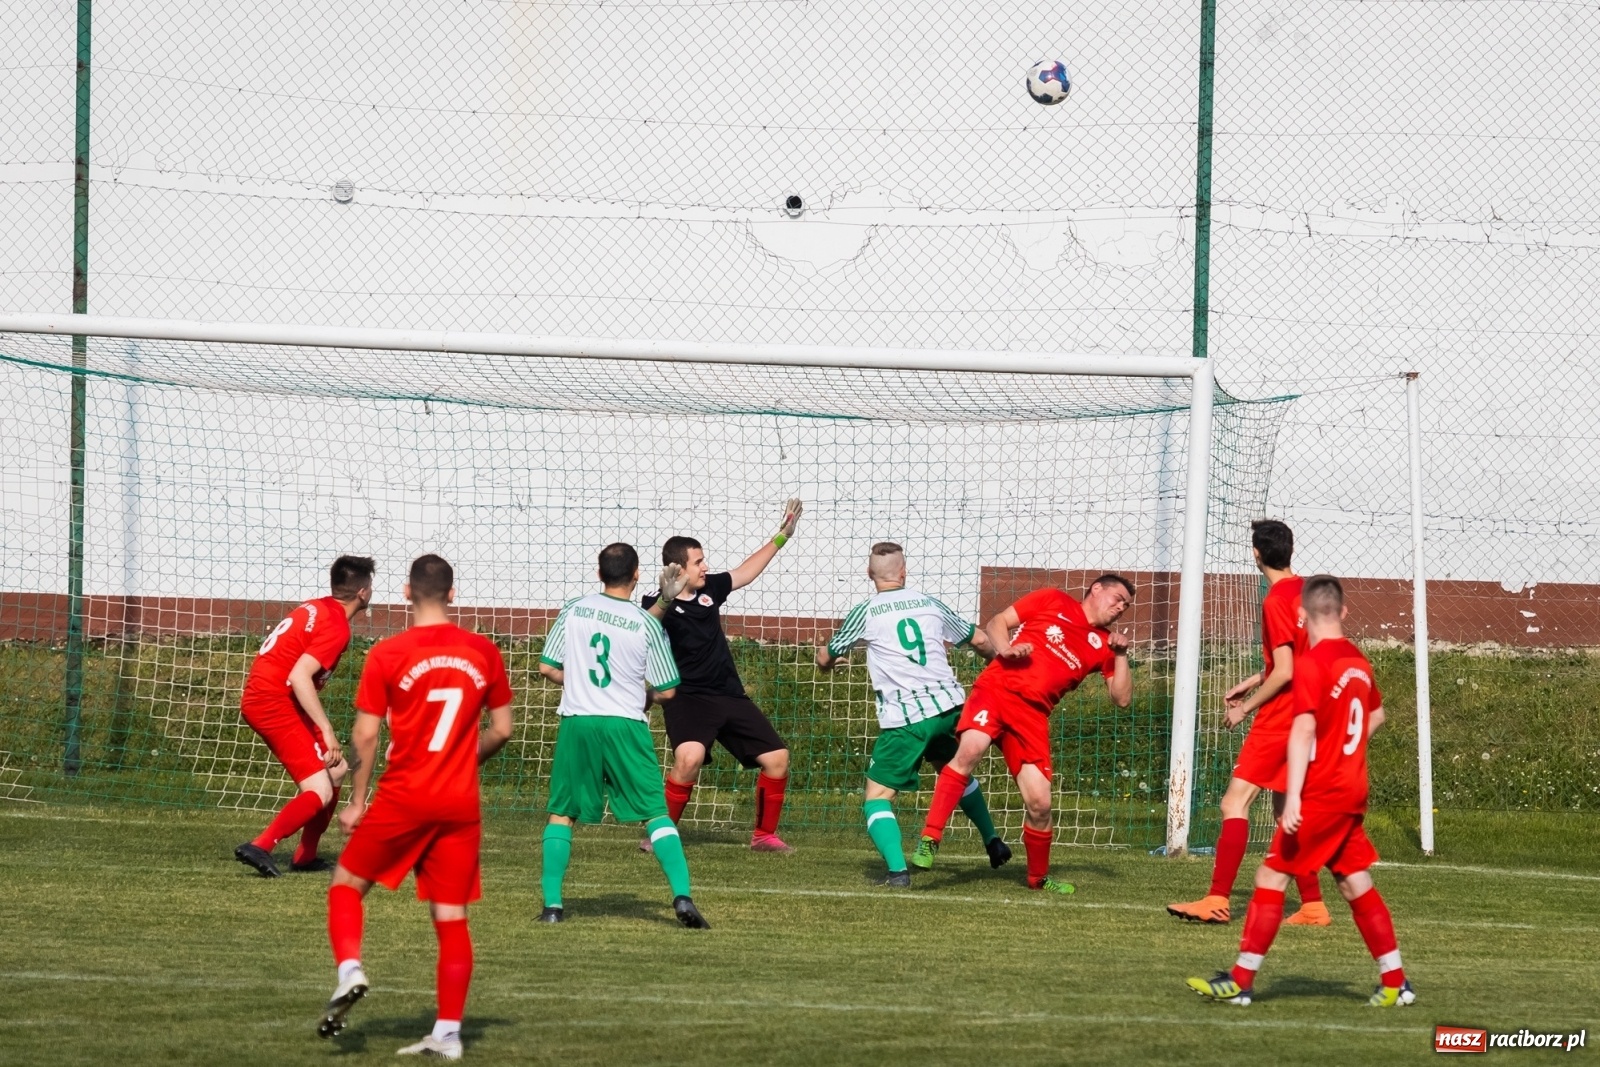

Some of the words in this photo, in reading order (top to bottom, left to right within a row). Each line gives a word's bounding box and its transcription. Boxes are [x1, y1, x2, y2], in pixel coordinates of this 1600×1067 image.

[573, 606, 596, 620] RUCH
[870, 602, 893, 618] RUCH
[259, 617, 293, 656] 8
[896, 617, 927, 667] 9
[588, 632, 612, 689] 3
[426, 687, 463, 752] 7
[972, 709, 989, 727] 4
[1342, 697, 1364, 756] 9
